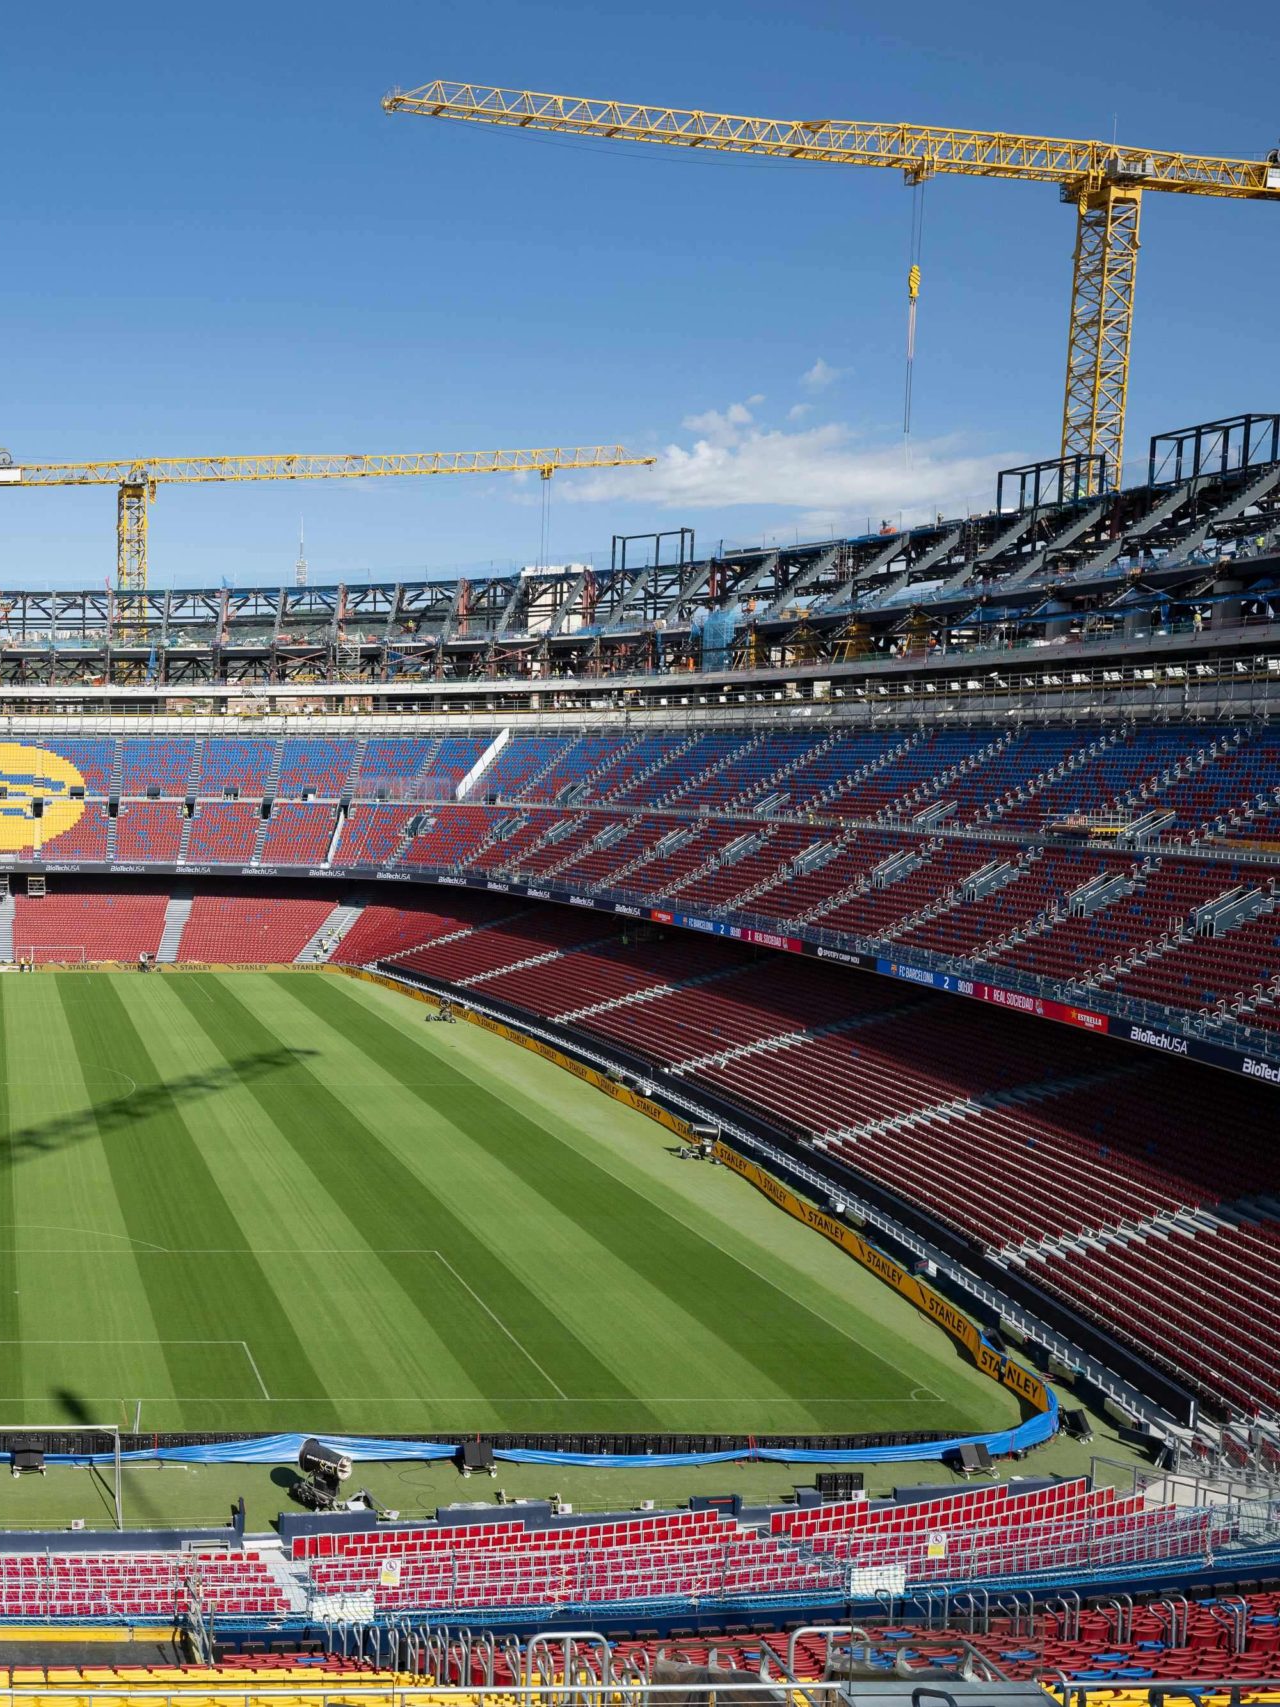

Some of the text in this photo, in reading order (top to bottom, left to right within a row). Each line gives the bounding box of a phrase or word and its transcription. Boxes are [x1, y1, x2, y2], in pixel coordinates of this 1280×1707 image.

[45, 864, 80, 872] BioTechUSA
[176, 866, 211, 874] BioTechUSA
[241, 867, 278, 875] BioTechUSA
[309, 869, 345, 877] BioTechUSA
[376, 872, 411, 880] BioTechUSA
[438, 876, 466, 885] BioTechUSA
[720, 924, 724, 934] 2
[748, 931, 751, 941] 1
[898, 964, 1033, 1010] FC BARCELONA 2 90:00 1 REAL SOCIEDAD
[1077, 1012, 1102, 1026] ESTRELLA
[1130, 1026, 1187, 1055] BioTechUSA
[601, 1079, 618, 1096] STANLEY
[636, 1099, 661, 1118] STANLEY
[720, 1148, 748, 1171] STANLEY
[764, 1175, 786, 1203] STANLEY
[808, 1211, 845, 1241] STANLEY
[867, 1251, 903, 1285] STANLEY
[929, 1299, 968, 1336] STANLEY
[981, 1350, 1039, 1399] STANLEY
